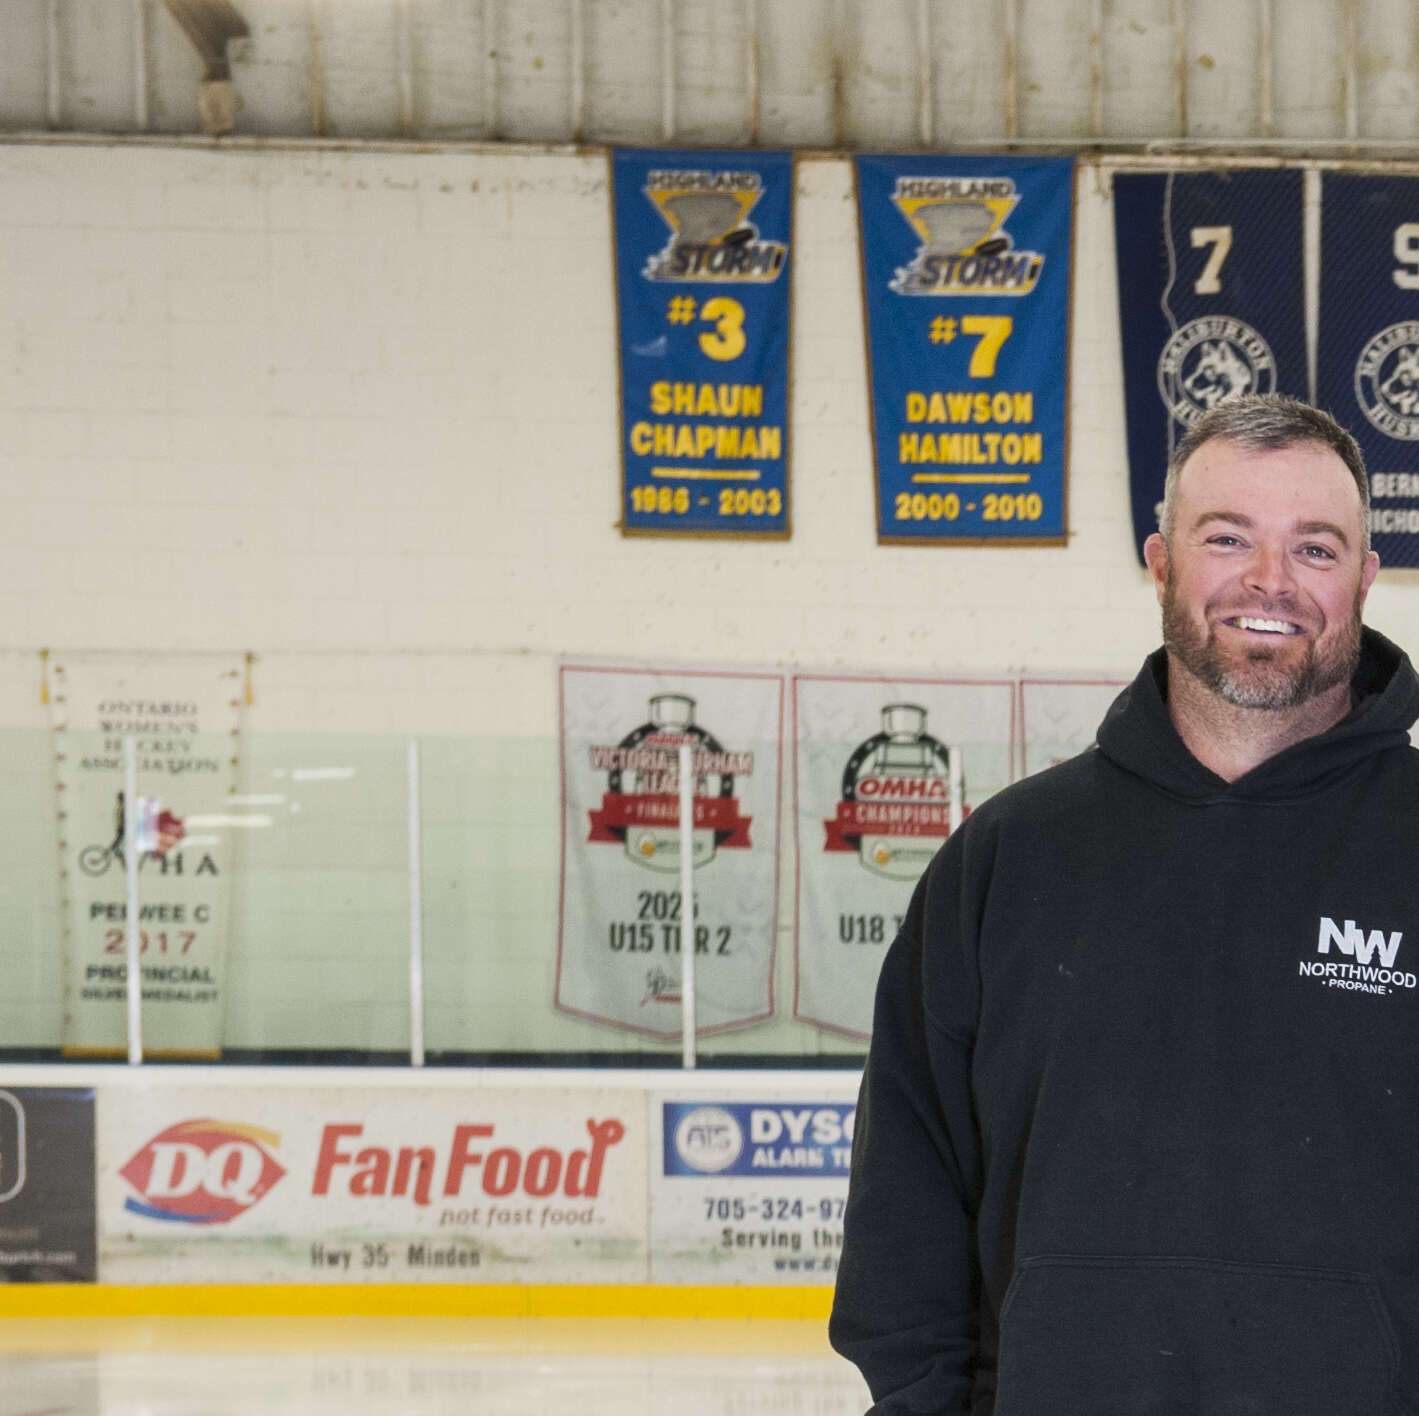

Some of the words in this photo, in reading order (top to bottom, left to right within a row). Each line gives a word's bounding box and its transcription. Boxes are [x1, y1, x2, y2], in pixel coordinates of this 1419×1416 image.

[650, 173, 759, 190] HIGHLAND
[900, 180, 1014, 198] HIGHLAND
[670, 243, 773, 275] STORM
[921, 254, 1028, 286] STORM
[1190, 226, 1233, 294] 7
[667, 296, 747, 361] #3
[928, 315, 1013, 379] #7
[650, 382, 763, 417] SHAUN
[906, 392, 1033, 424] DAWSON
[631, 422, 781, 459] CHAPMAN
[898, 433, 1042, 465] HAMILTON
[719, 488, 782, 516] 2003
[895, 493, 960, 521] 2000
[983, 493, 1042, 521] 2010
[858, 777, 948, 799] OMHA
[193, 903, 211, 924] C
[609, 921, 654, 952] U15
[660, 923, 709, 955] TIR
[716, 926, 732, 956] 2
[838, 913, 885, 944] U18
[1317, 917, 1403, 968] NW
[86, 964, 214, 985] PROINCIAL
[1298, 961, 1417, 989] NORTHWOOD
[1328, 978, 1386, 995] PROPANE
[752, 1147, 824, 1168] ALARM
[144, 1140, 267, 1206] DQ
[439, 1206, 479, 1226] not
[486, 1204, 536, 1229] fast
[705, 1196, 844, 1221] 705-324-97
[721, 1228, 802, 1250] Serving
[310, 1243, 351, 1270] Hwy
[362, 1244, 389, 1268] 35
[407, 1244, 481, 1268] Minden
